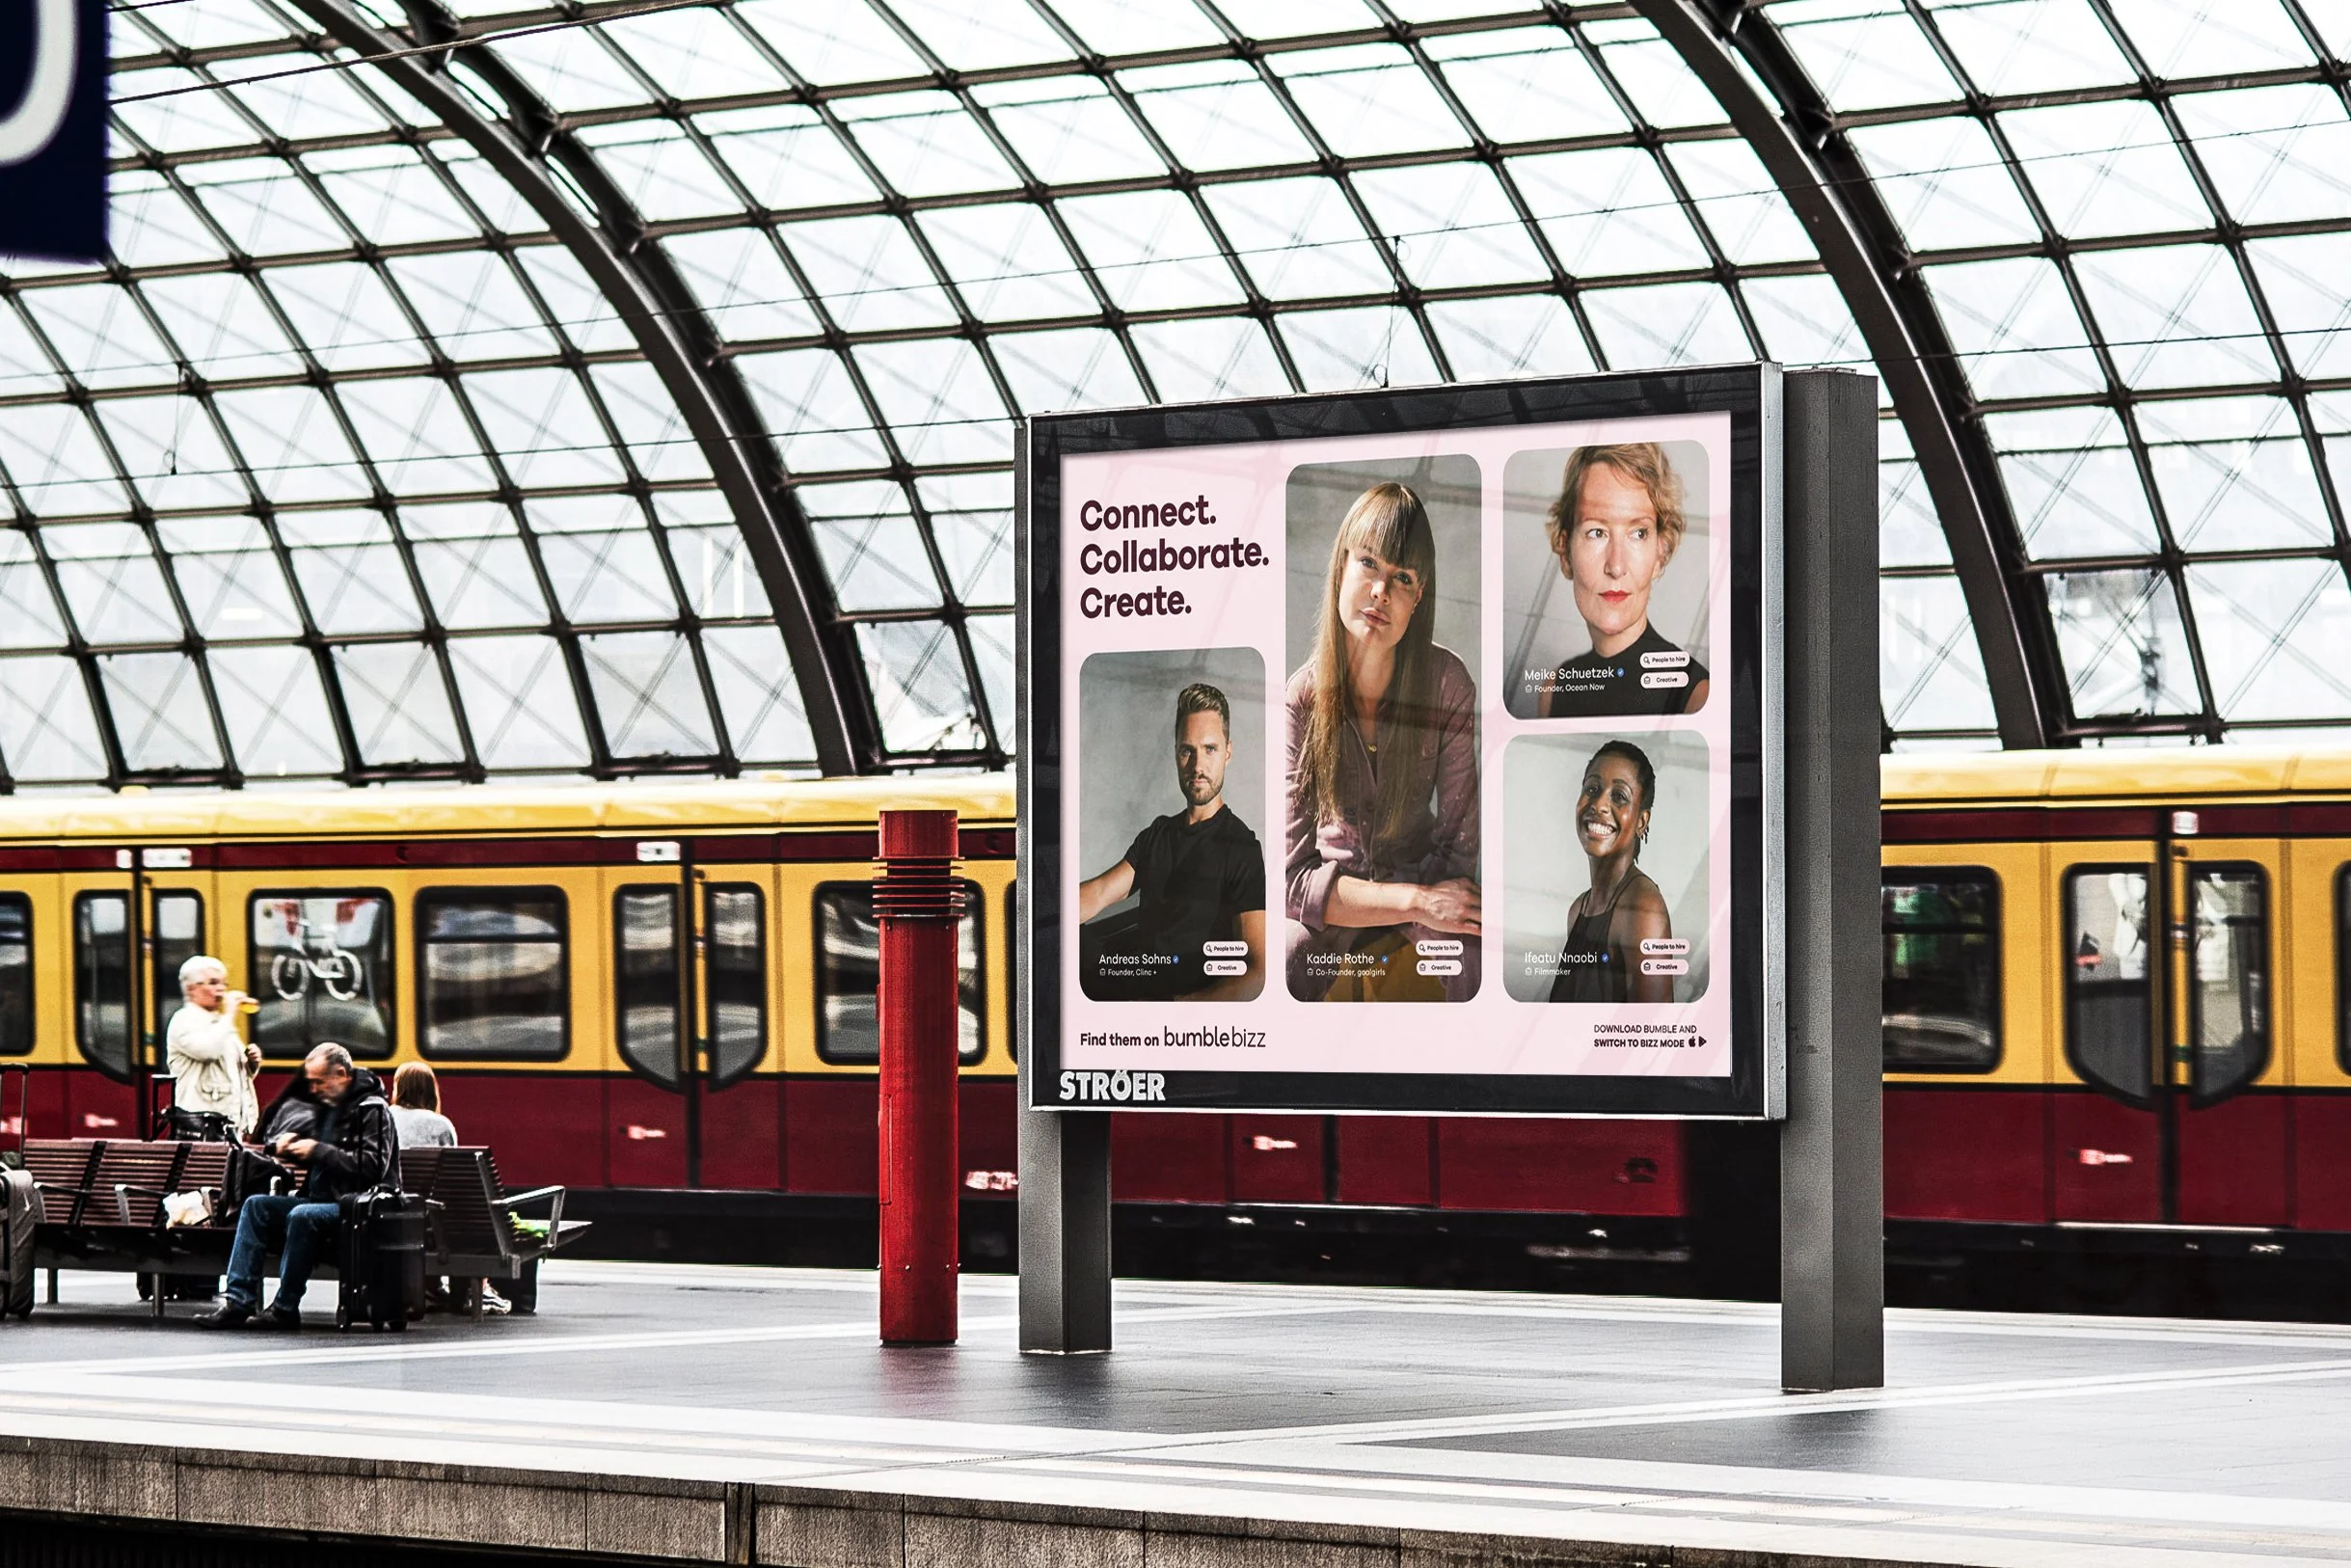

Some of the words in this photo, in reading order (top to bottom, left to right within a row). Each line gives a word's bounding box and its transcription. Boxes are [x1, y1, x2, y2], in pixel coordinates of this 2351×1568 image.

[1080, 495, 1216, 531] Connect.
[1080, 537, 1269, 576] Collaborate.
[1080, 585, 1192, 619] Create.
[1525, 668, 1556, 681] Meike
[1558, 665, 1614, 680] Schuetzek
[1534, 684, 1564, 692] Founder,
[1565, 683, 1588, 691] Ocean
[1589, 682, 1606, 690] Now
[1426, 944, 1444, 953] People
[1099, 954, 1140, 964] Andreas
[1142, 953, 1172, 964] Sohns
[1307, 953, 1342, 964] Kaddie
[1344, 953, 1375, 964] Rothe
[1525, 952, 1555, 963] Ifeatu
[1558, 952, 1597, 963] Nnaobi
[1108, 968, 1135, 977] Founder,
[1315, 968, 1357, 977] Co-Founder,
[1534, 967, 1571, 976] Filmmaker
[1594, 1024, 1642, 1034] DOWNLOAD
[1643, 1024, 1677, 1034] BUMBLE
[1679, 1025, 1697, 1034] AND
[1080, 1032, 1107, 1046] Find
[1109, 1033, 1142, 1046] them
[1144, 1036, 1159, 1046] on
[1594, 1039, 1626, 1047] SWITCH
[1628, 1039, 1638, 1047] TO
[1640, 1039, 1659, 1047] BIZZ
[1660, 1039, 1685, 1048] MODE
[1060, 1069, 1166, 1101] STRÖER
